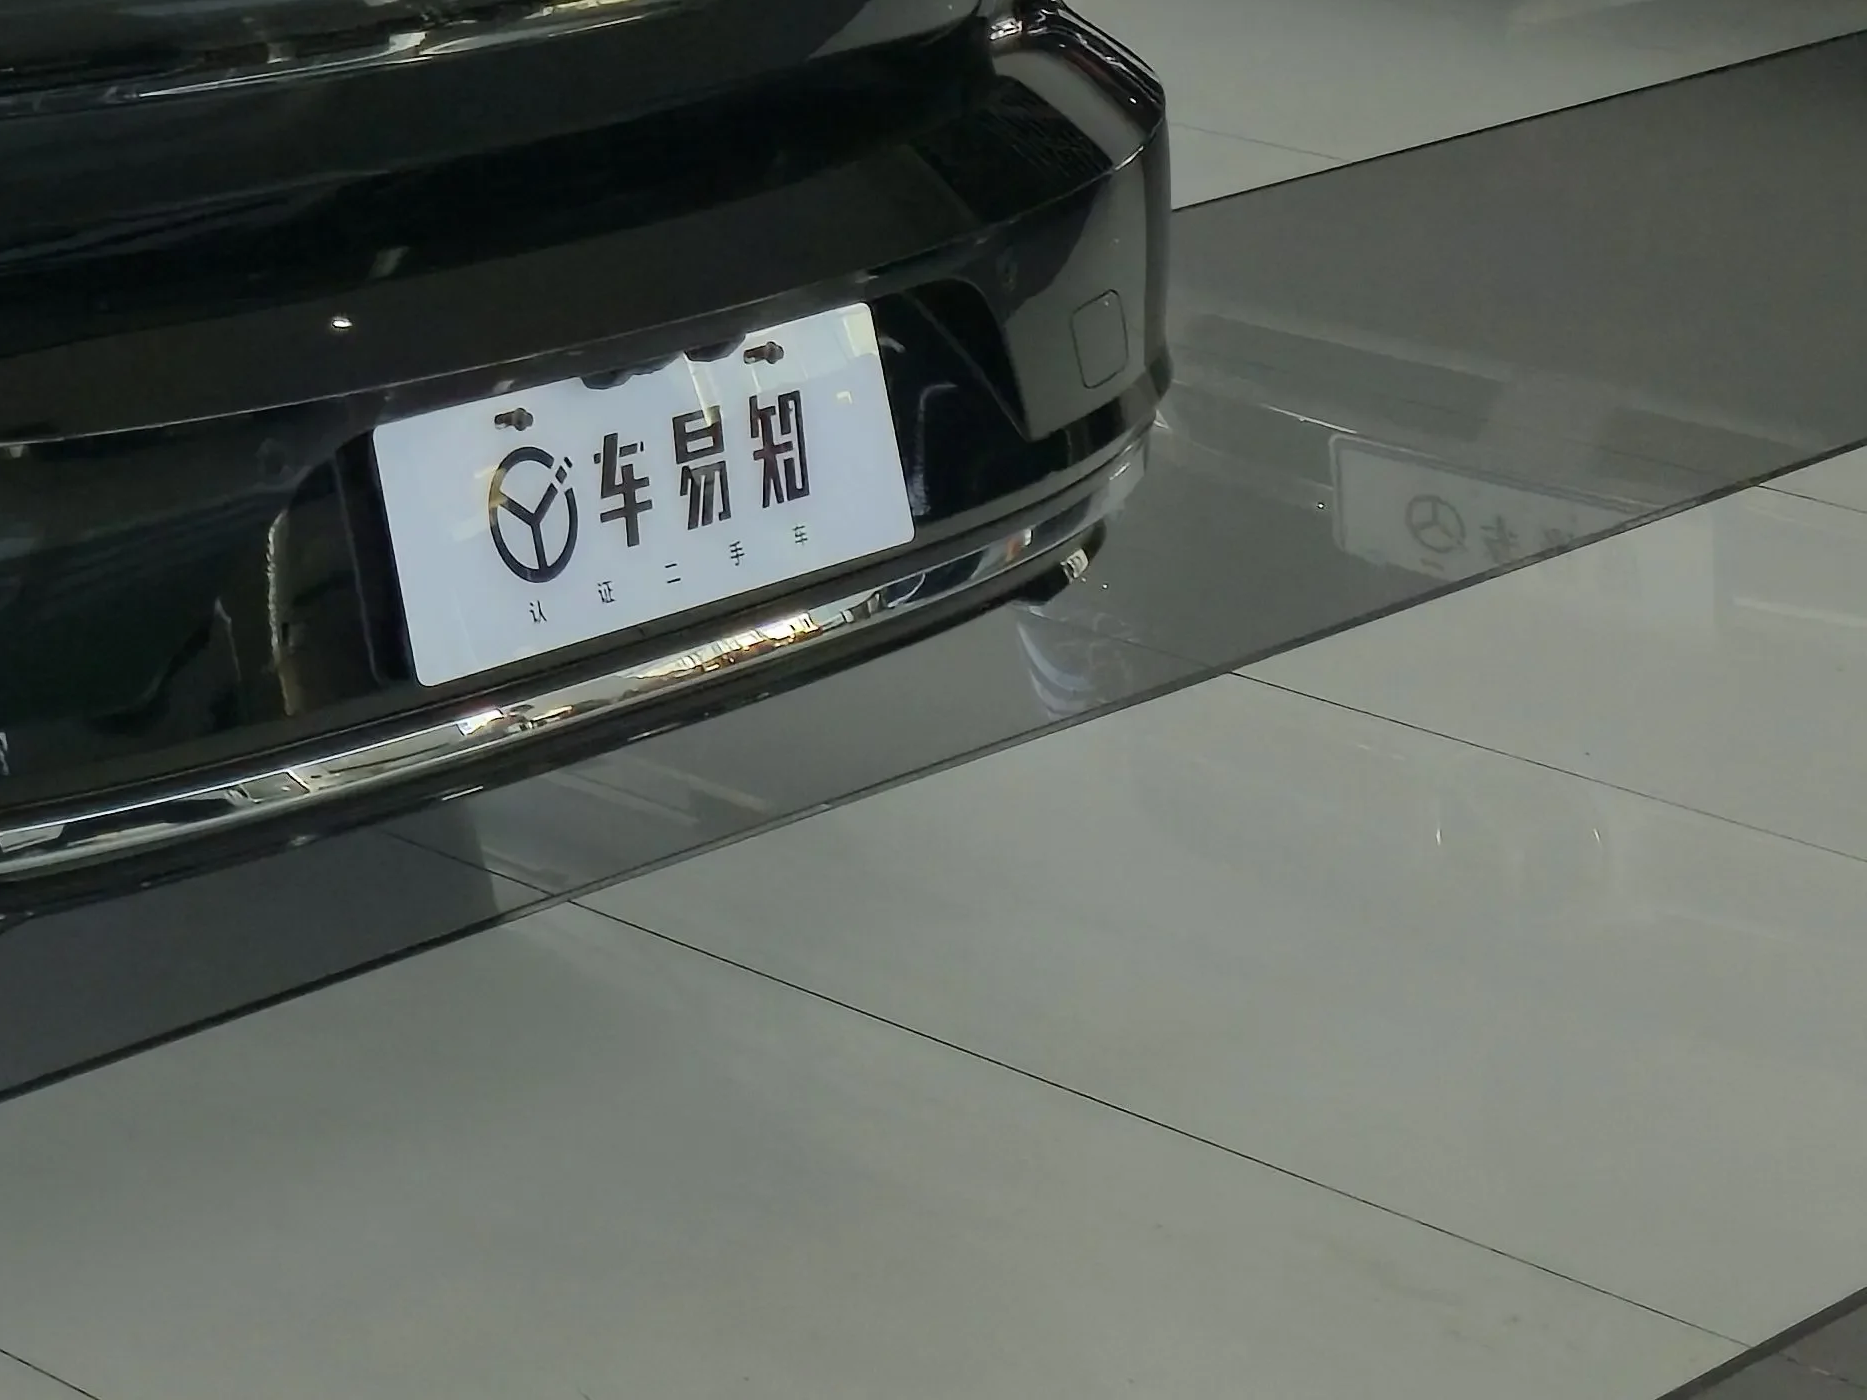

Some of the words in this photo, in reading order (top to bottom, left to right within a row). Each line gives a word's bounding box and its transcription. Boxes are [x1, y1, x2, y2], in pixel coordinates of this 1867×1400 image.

[593, 389, 810, 548] 车易知
[529, 525, 809, 624] 认证二手车
